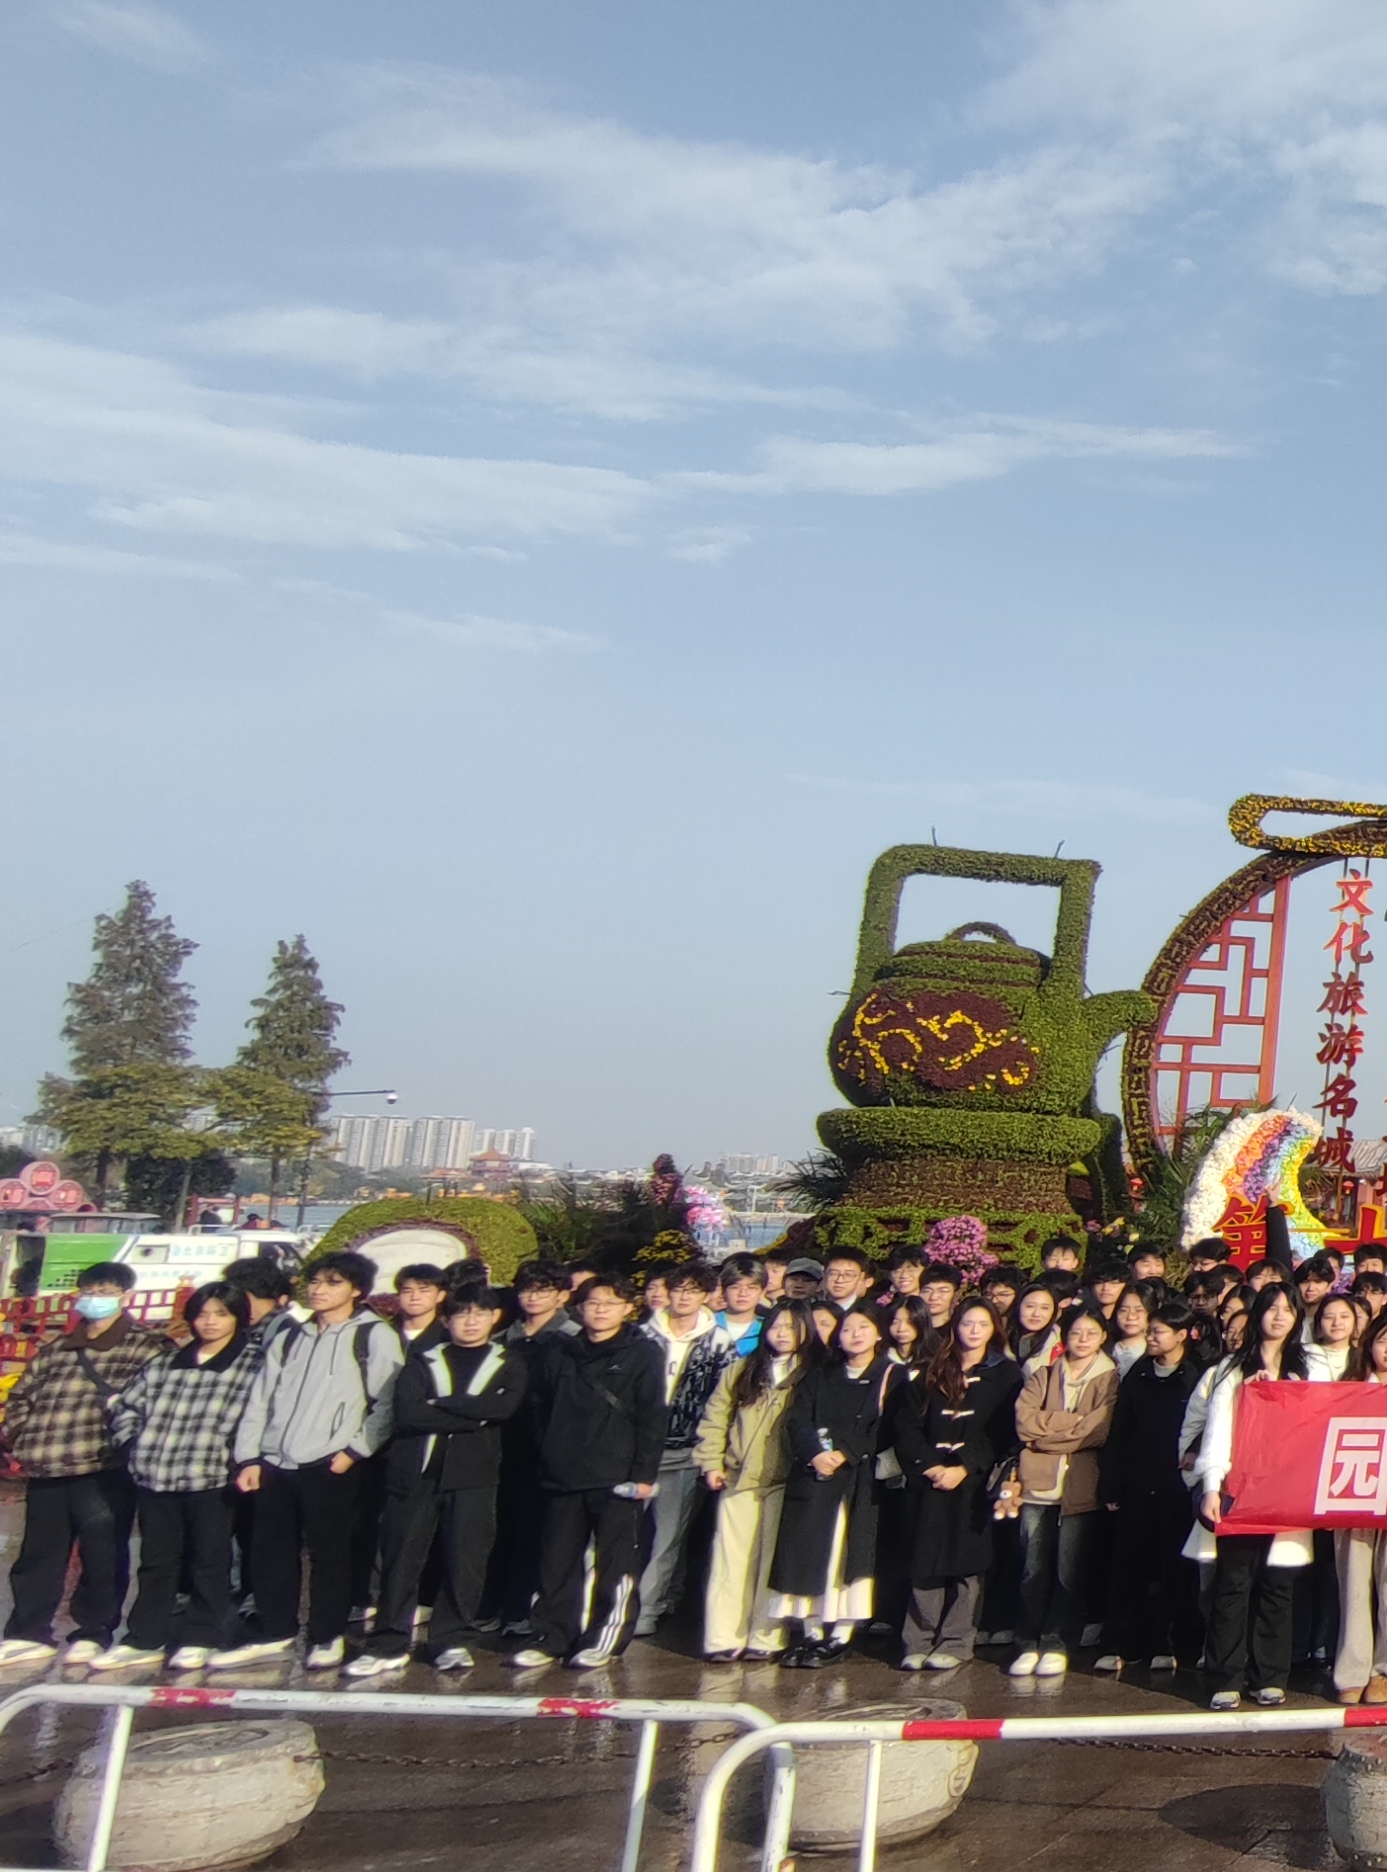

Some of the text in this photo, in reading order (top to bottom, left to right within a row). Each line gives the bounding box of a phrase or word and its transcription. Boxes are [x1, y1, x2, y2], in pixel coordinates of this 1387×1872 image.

[1312, 868, 1374, 1175] 文化旅游名城
